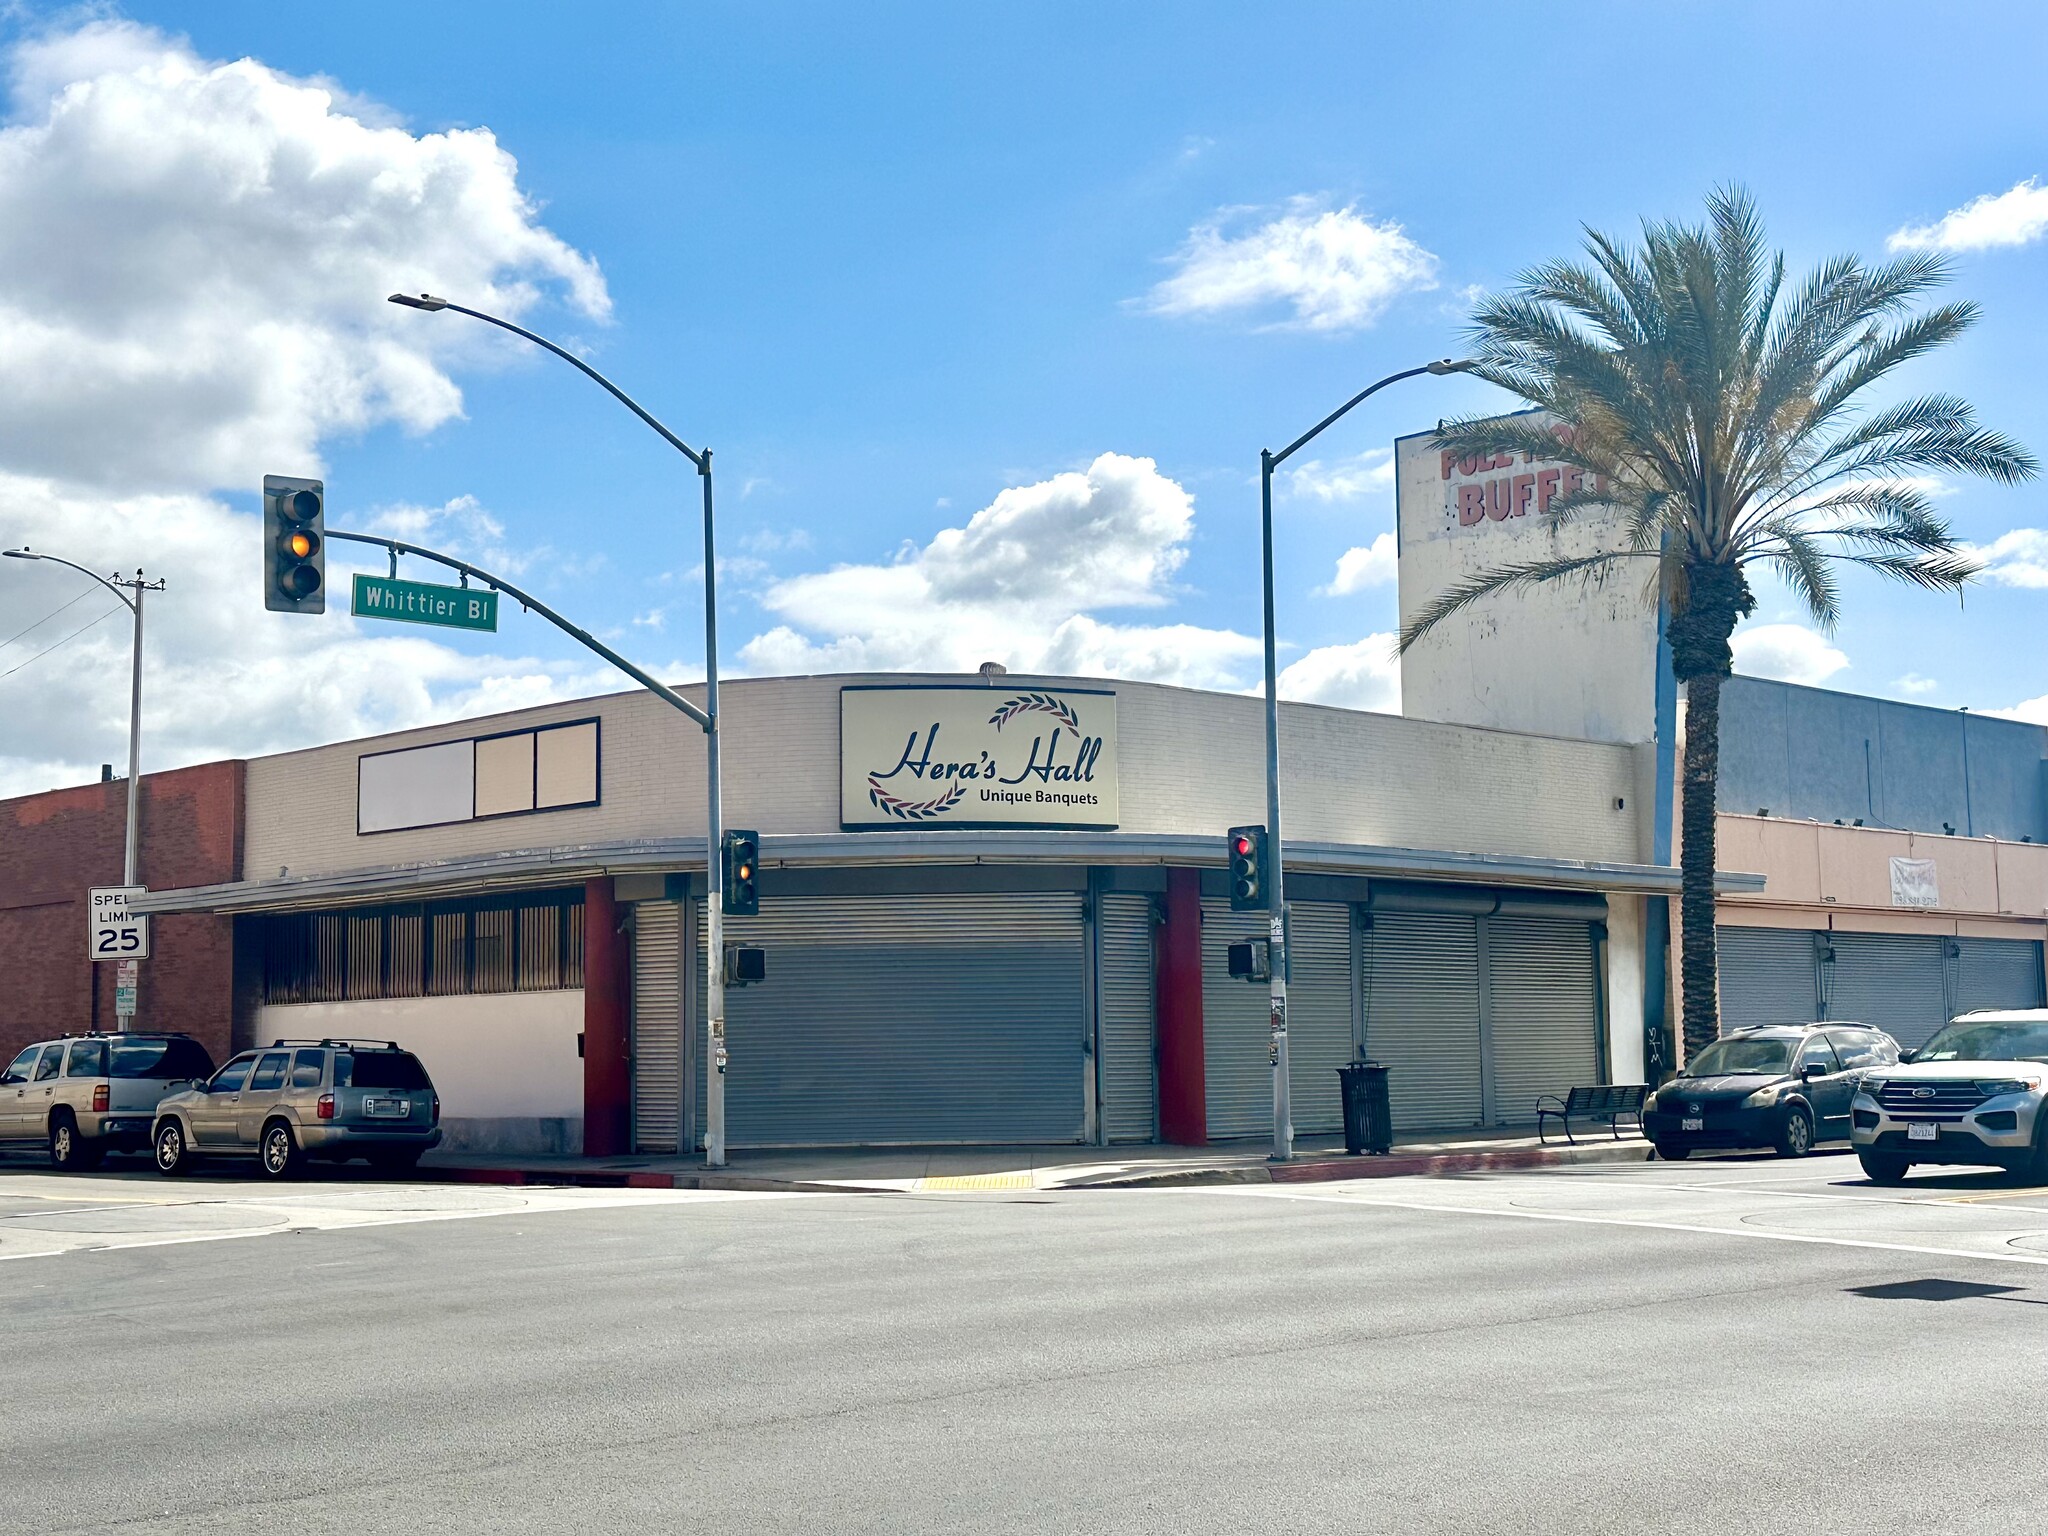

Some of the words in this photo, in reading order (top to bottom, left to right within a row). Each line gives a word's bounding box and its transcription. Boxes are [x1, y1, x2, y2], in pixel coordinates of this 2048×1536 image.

[366, 585, 457, 616] Whittier
[468, 599, 488, 621] Bl
[869, 722, 996, 780] Hera's
[998, 727, 1103, 785] Hall
[980, 788, 1032, 806] Unique
[1035, 789, 1099, 807] Banquets
[94, 894, 129, 906] SPE
[98, 927, 140, 953] 25
